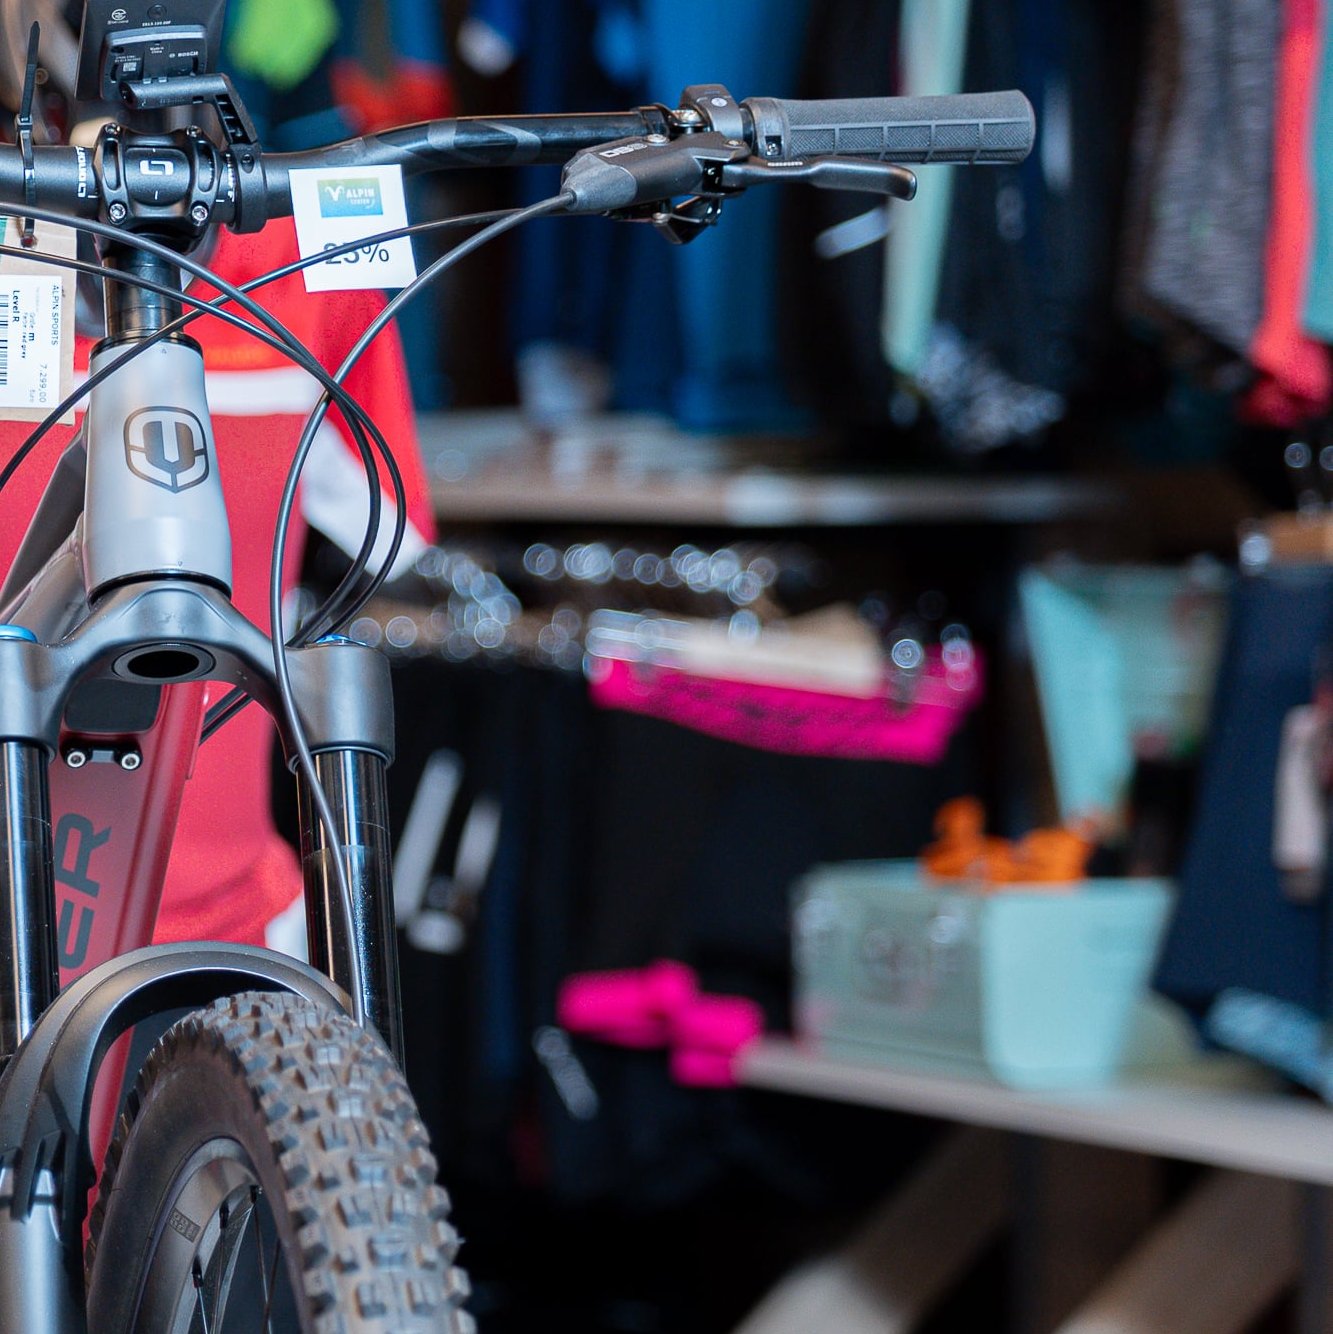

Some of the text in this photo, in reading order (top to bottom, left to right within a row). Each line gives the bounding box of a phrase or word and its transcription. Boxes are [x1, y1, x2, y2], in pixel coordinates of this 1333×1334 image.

[347, 187, 375, 199] ALPIN
[51, 284, 60, 346] ALPIN SPORTS
[39, 364, 48, 403] 7.299,00
